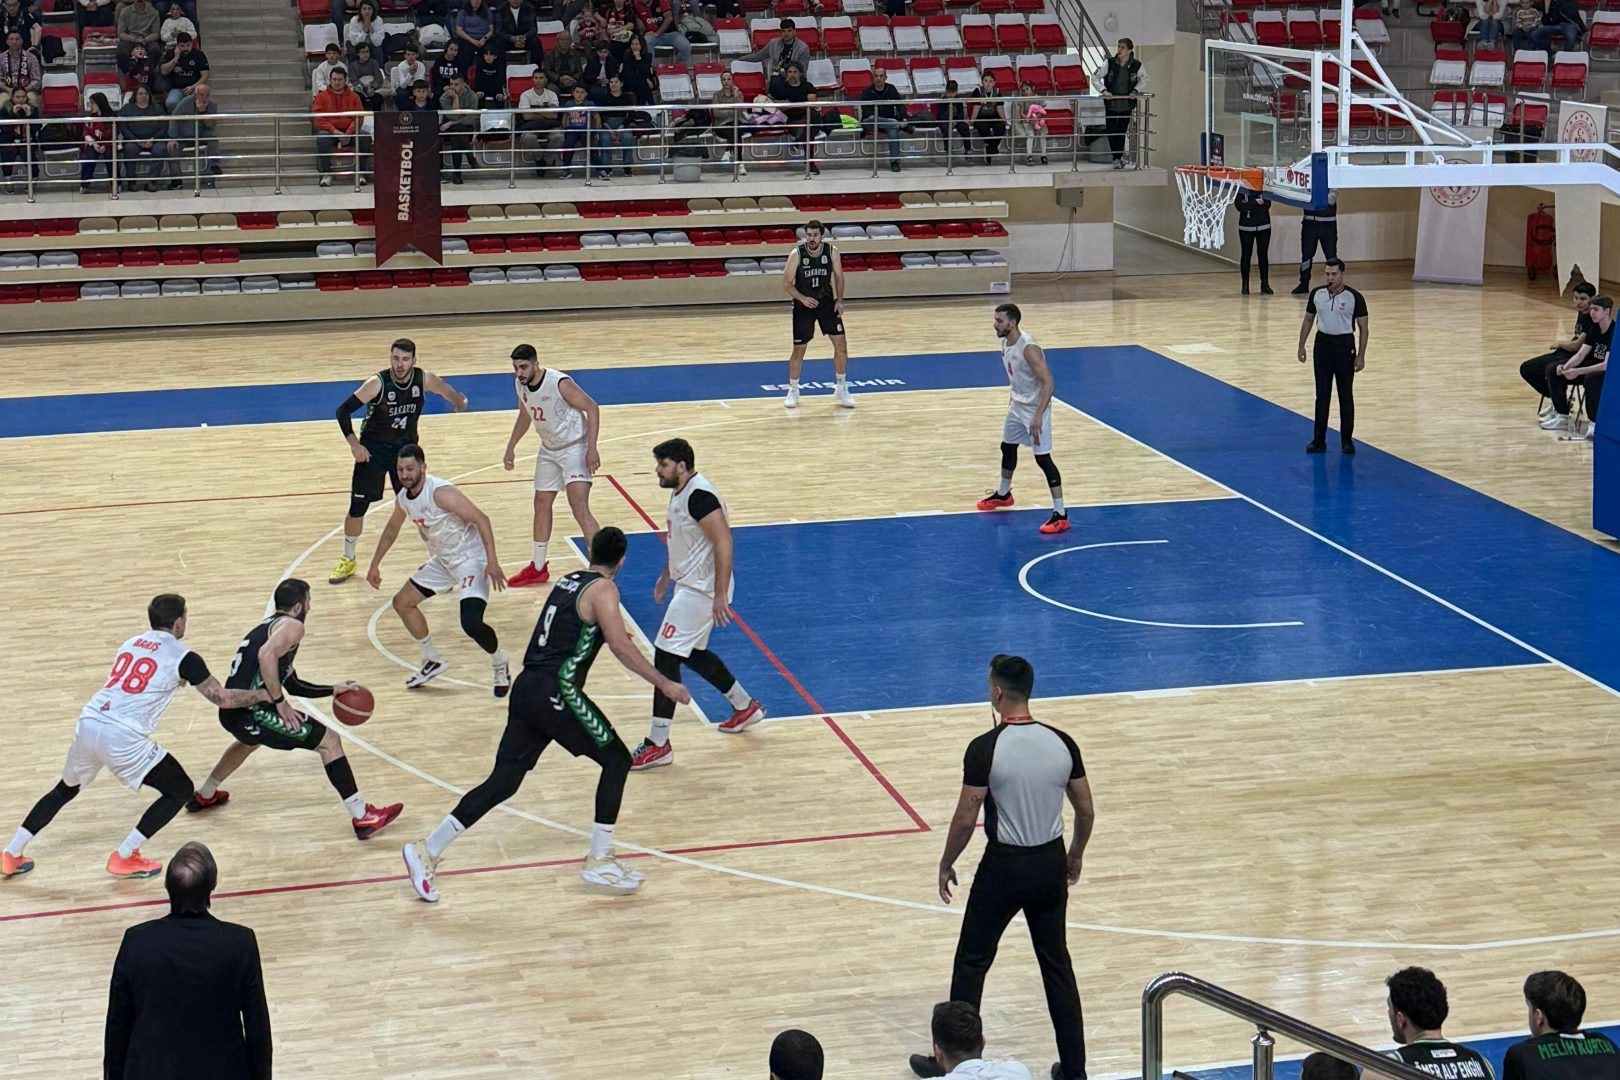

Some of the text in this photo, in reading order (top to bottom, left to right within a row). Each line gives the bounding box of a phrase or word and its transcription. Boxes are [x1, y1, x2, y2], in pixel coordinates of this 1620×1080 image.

[439, 66, 458, 76] BEST
[397, 140, 414, 221] BASKETBOL
[1294, 170, 1310, 188] TBF
[811, 277, 819, 288] 11
[530, 406, 546, 422] 22
[391, 416, 408, 430] 24
[461, 575, 475, 589] 27
[661, 622, 677, 640] 10
[104, 652, 159, 695] 98
[1441, 1062, 1459, 1080] ALP
